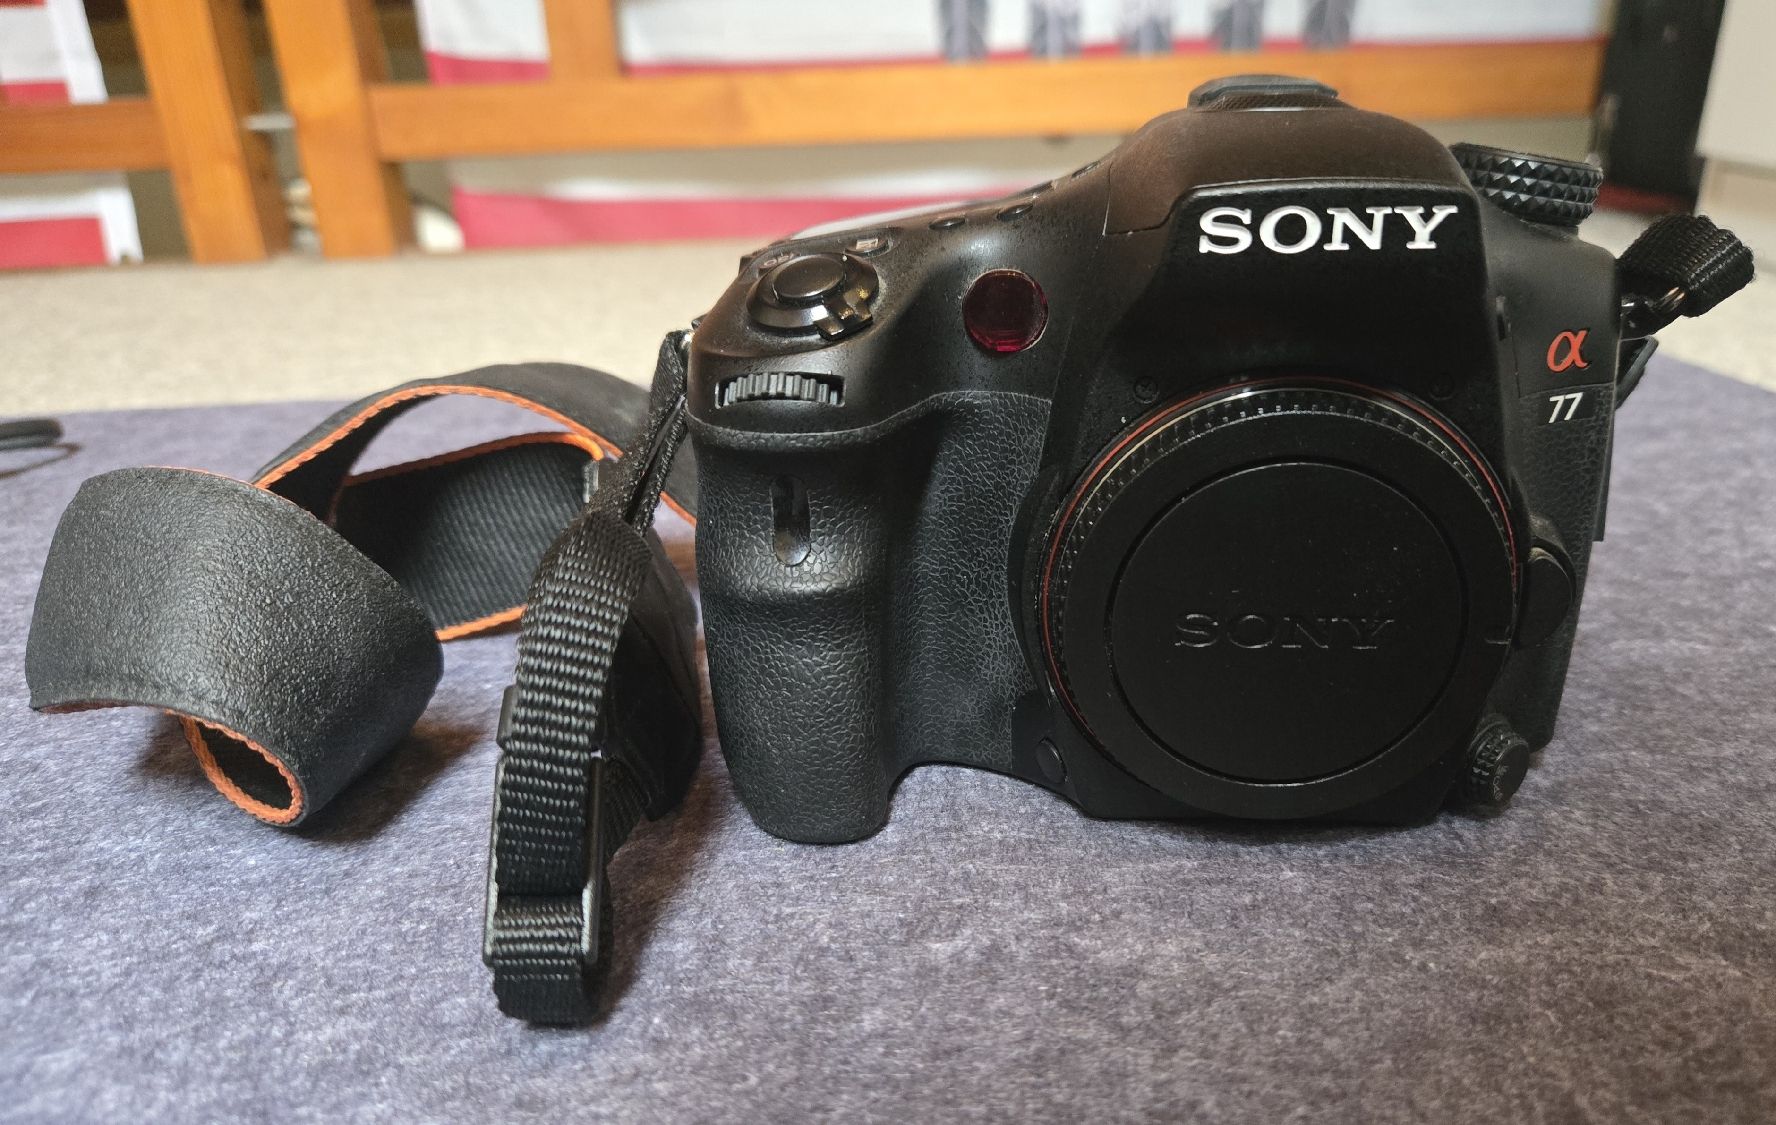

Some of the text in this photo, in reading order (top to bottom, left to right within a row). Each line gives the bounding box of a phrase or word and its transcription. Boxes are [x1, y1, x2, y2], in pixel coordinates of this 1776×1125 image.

[1198, 205, 1458, 254] SONY
[1548, 391, 1584, 424] 77
[1174, 613, 1396, 650] SONY
